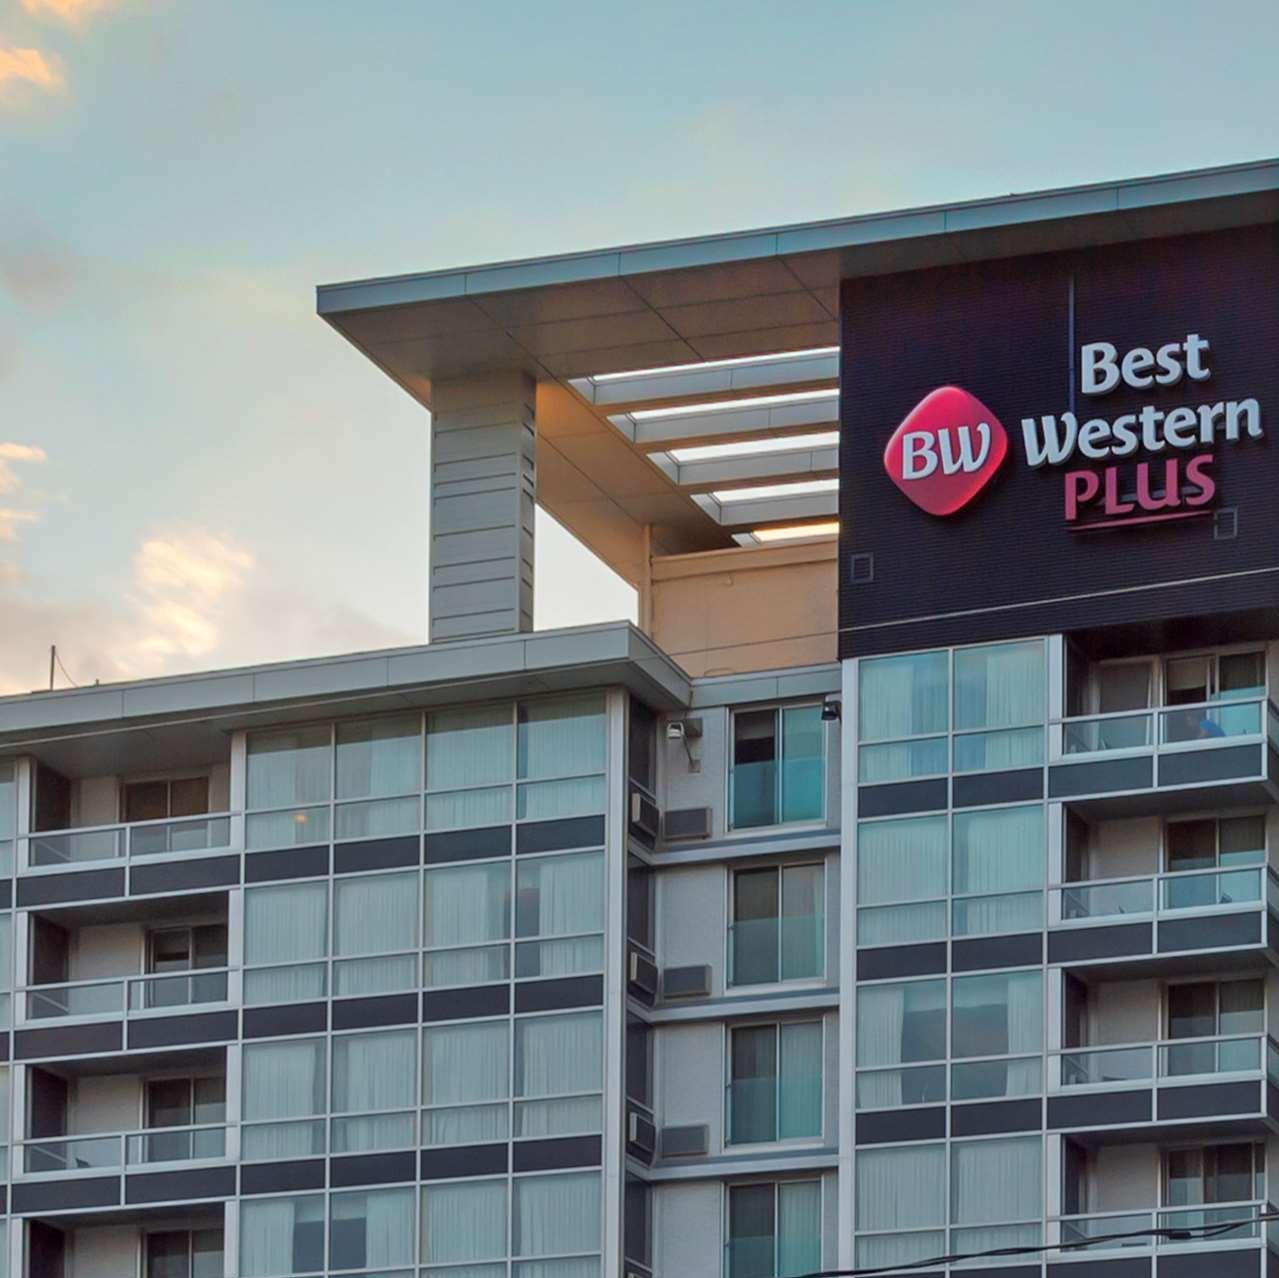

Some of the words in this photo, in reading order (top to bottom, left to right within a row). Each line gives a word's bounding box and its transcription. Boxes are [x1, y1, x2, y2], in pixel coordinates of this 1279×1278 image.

[1080, 334, 1211, 396] Best
[902, 422, 991, 480] BW
[1021, 398, 1264, 467] Western
[1064, 454, 1217, 521] PLUS
